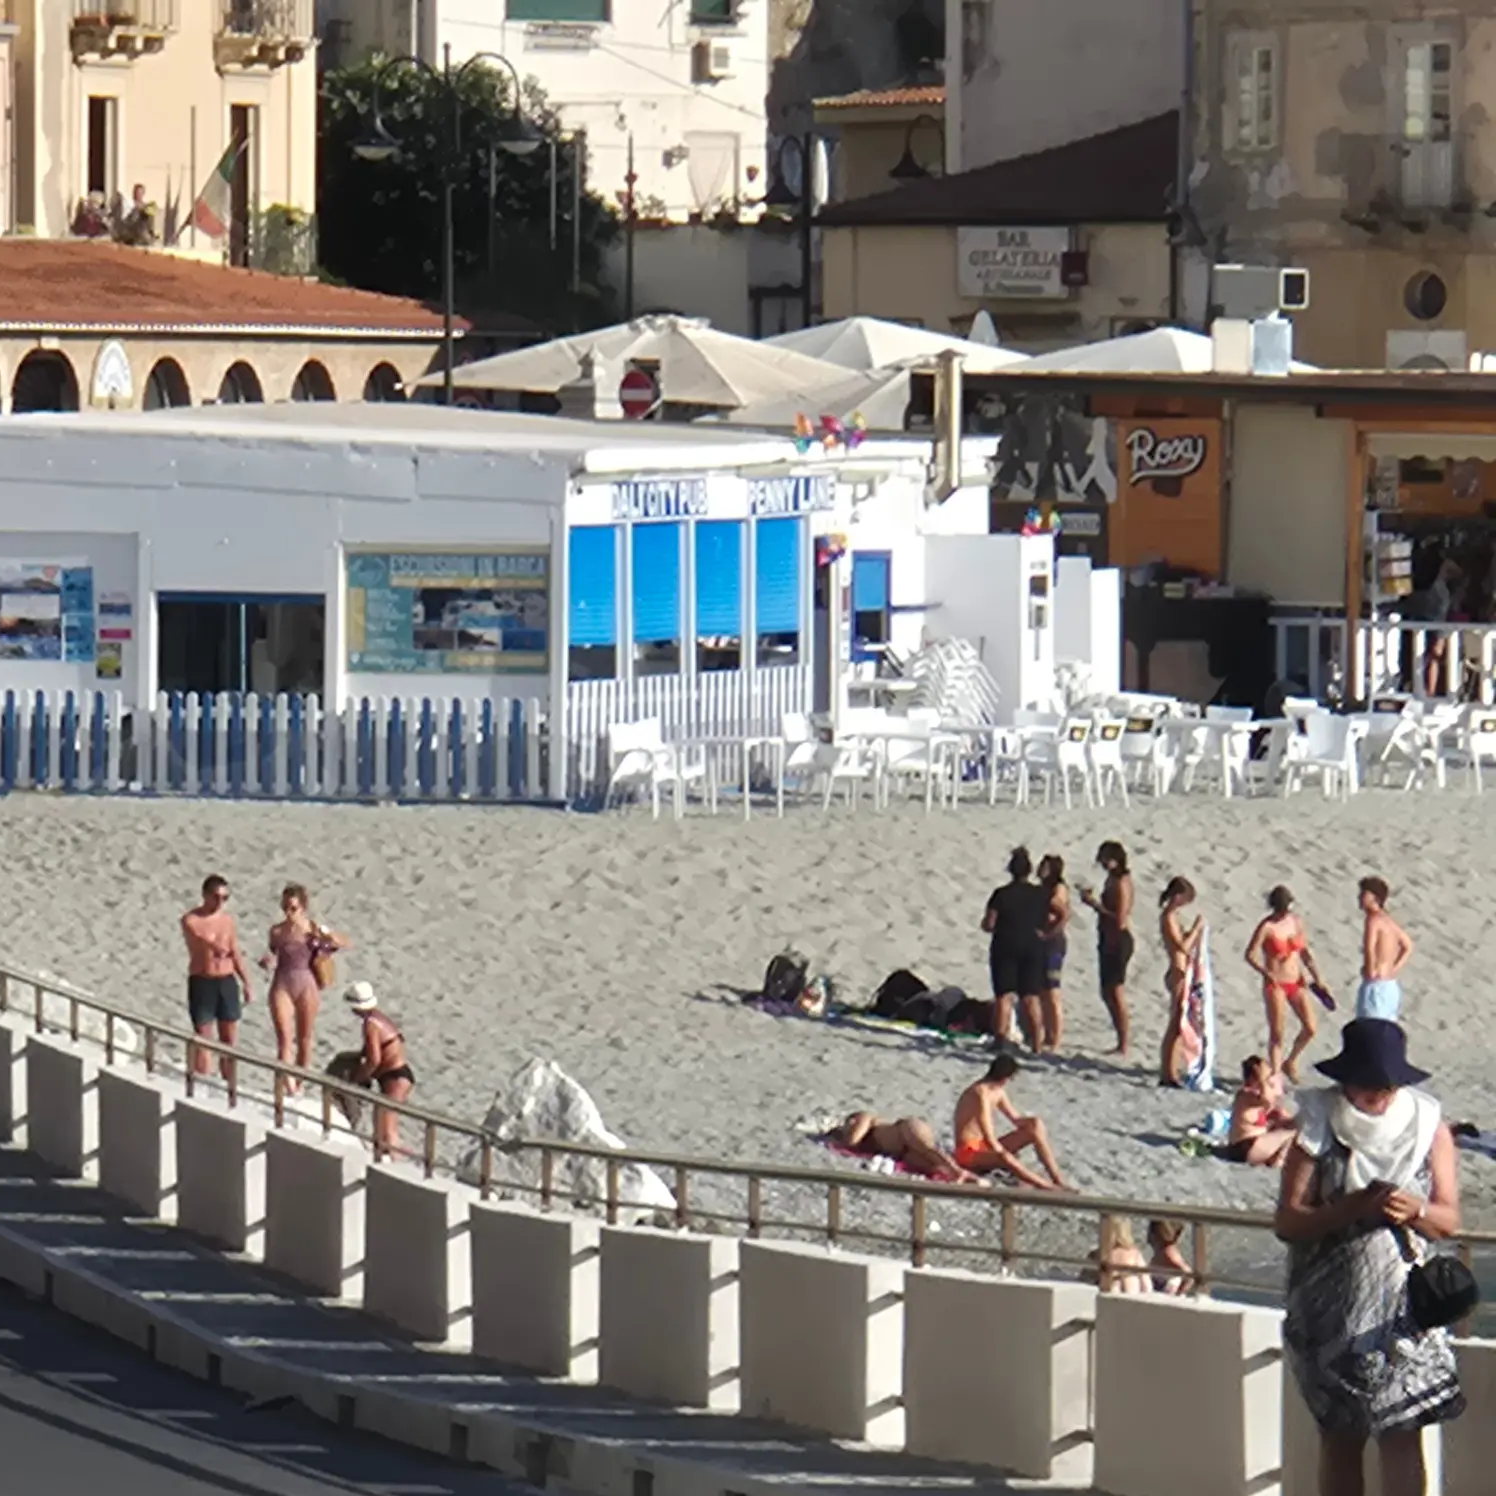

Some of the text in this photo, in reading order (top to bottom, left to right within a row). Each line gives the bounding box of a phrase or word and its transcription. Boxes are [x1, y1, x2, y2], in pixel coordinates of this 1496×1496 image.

[997, 230, 1031, 248] BAR
[1126, 429, 1204, 484] Roxy
[748, 475, 836, 514] PENNY LANE
